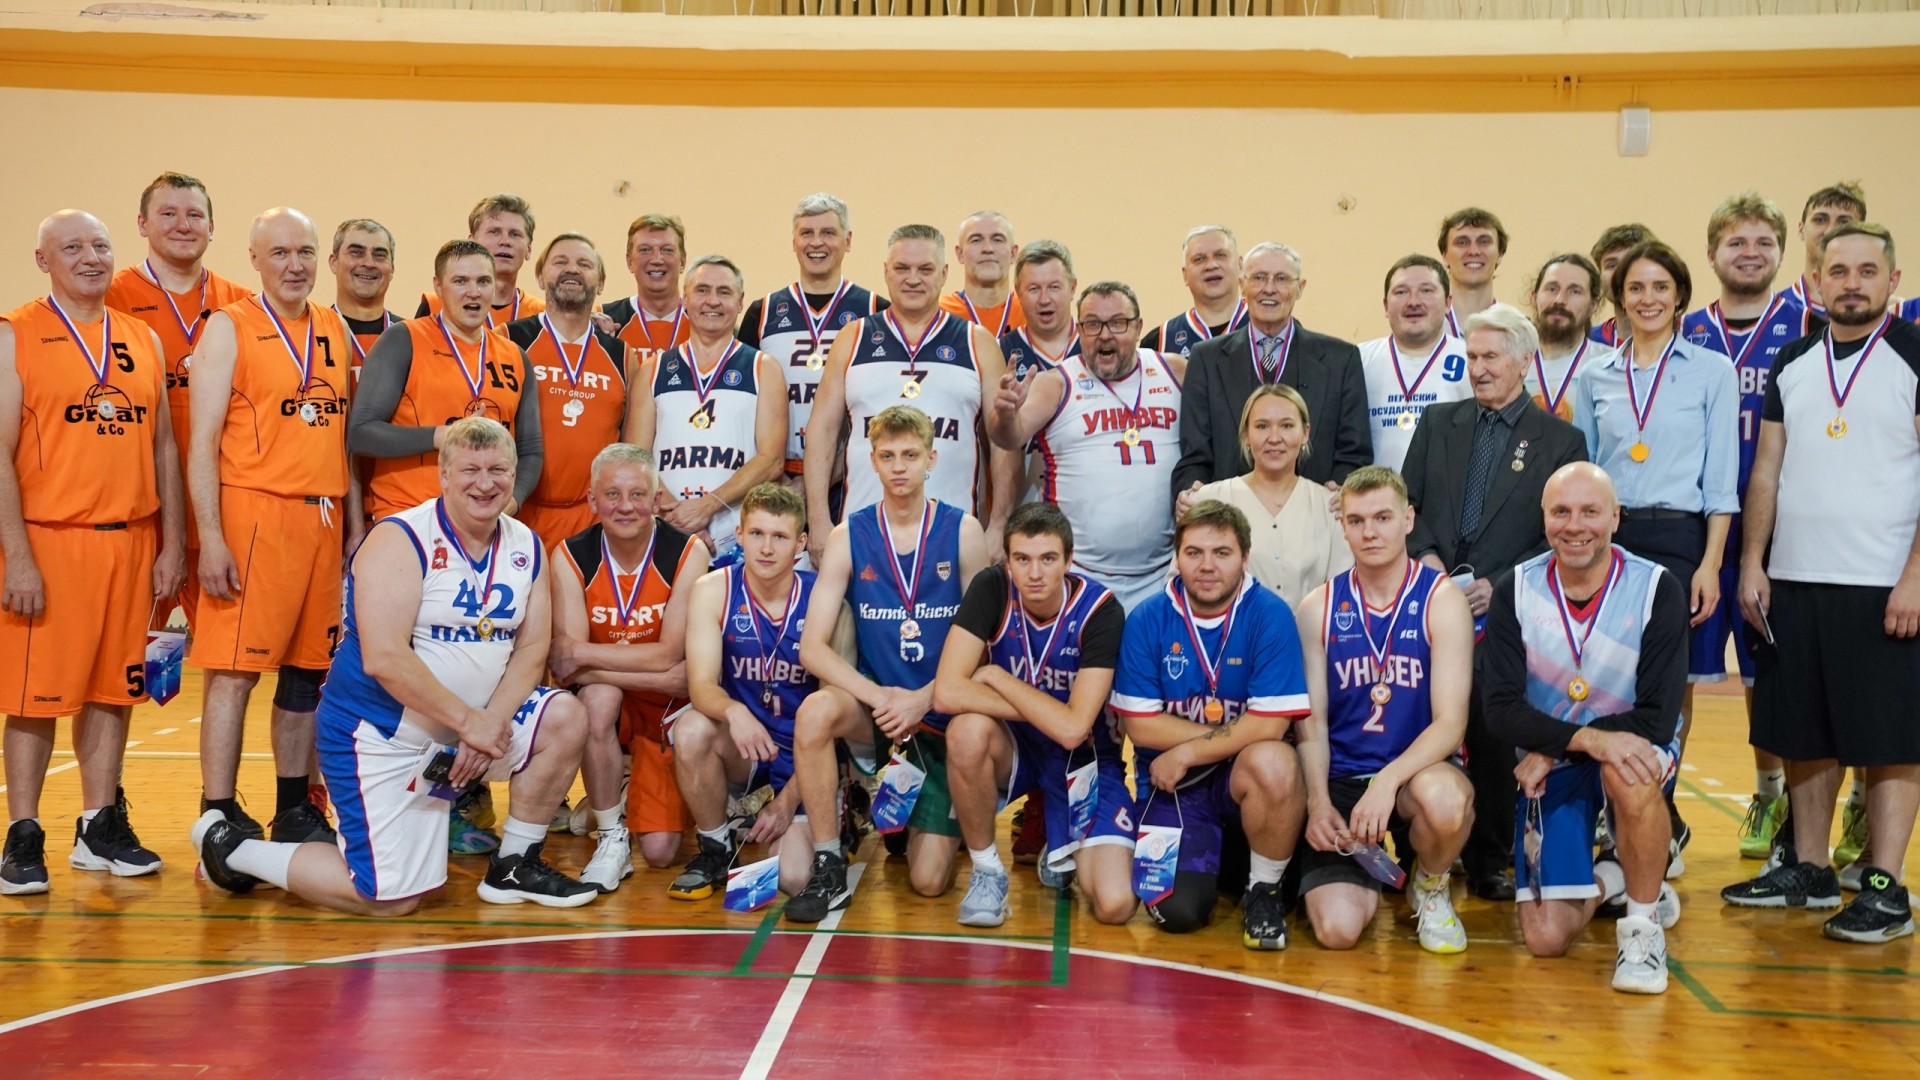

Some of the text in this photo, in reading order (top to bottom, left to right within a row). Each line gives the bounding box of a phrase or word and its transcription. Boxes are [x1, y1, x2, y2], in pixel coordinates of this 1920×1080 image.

[111, 342, 135, 373] 5
[315, 336, 335, 367] 7
[485, 361, 519, 393] 15
[533, 365, 611, 391] STRT
[1442, 354, 1465, 382] 9
[549, 387, 596, 399] CITY GROUP
[900, 370, 928, 398] 7
[1388, 392, 1437, 402] ПЕРСКИЙ
[318, 416, 329, 427] Co
[688, 398, 715, 428] 4
[1082, 406, 1178, 436] УНИВЕР
[97, 423, 125, 435] & Co
[659, 446, 745, 472] PARMA
[1113, 440, 1156, 465] 11
[452, 578, 517, 619] 42
[327, 625, 339, 658] 7
[627, 628, 654, 640] GROUP
[900, 630, 924, 662] 5
[126, 664, 144, 698] 5
[1362, 703, 1384, 732] 2
[1115, 806, 1134, 833] 6
